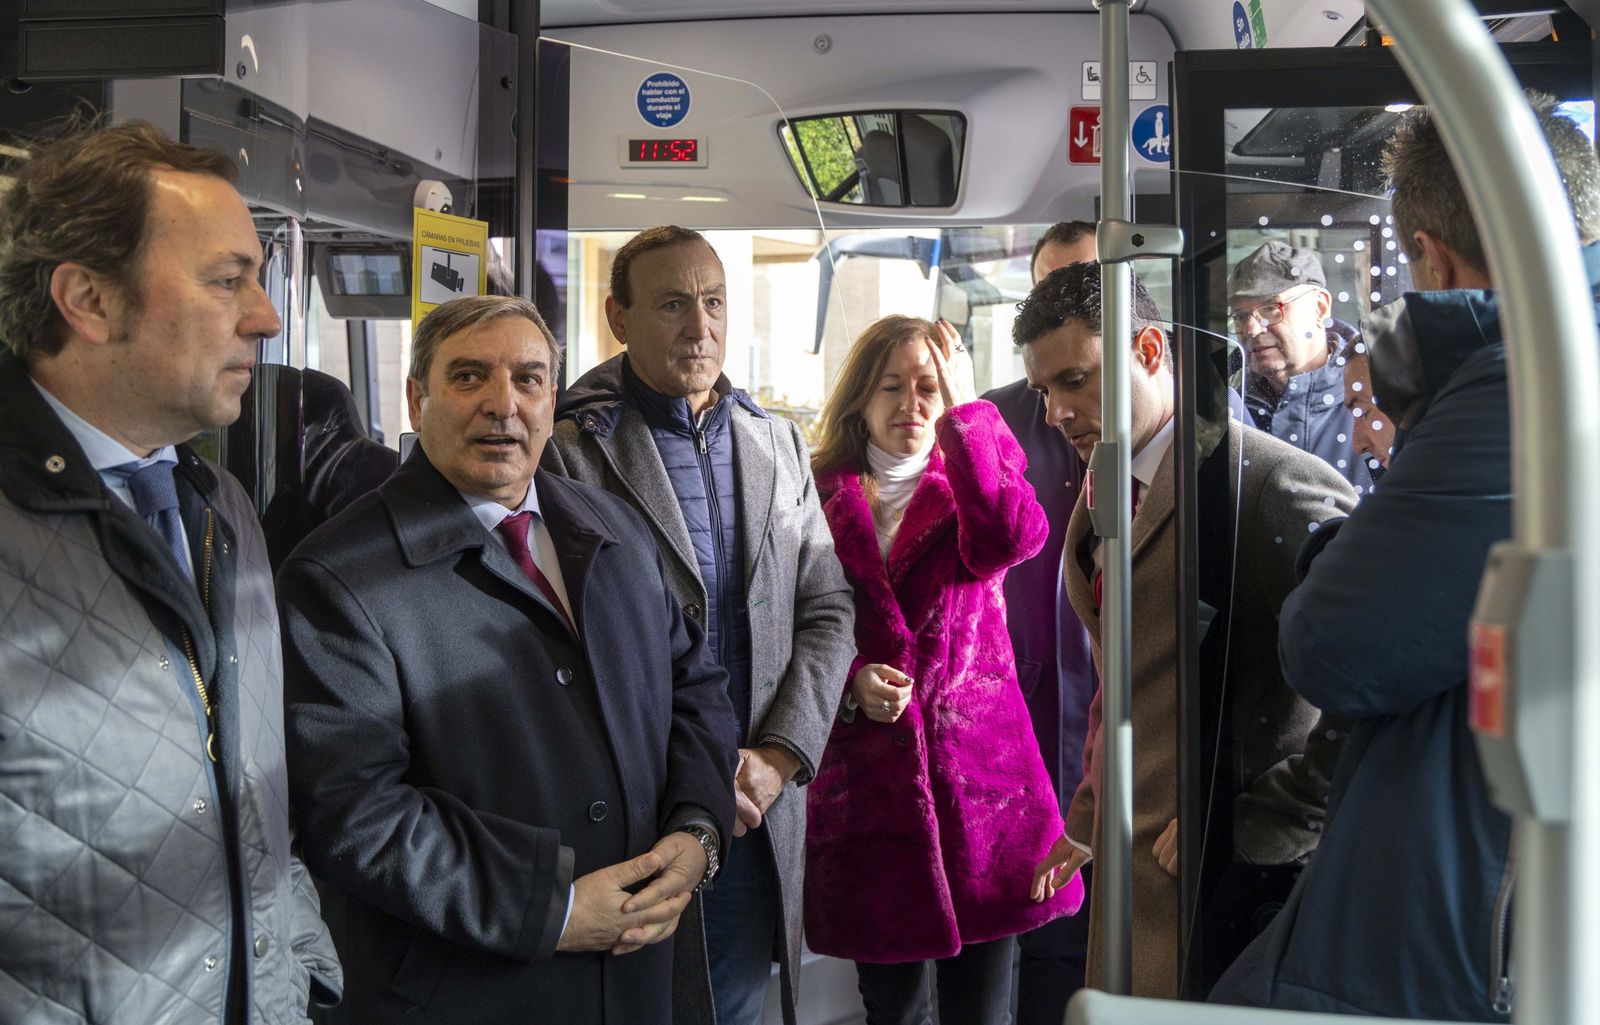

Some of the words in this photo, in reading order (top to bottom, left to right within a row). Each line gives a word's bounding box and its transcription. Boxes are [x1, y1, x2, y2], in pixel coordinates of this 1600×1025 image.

[640, 140, 696, 161] 11:52
[421, 230, 447, 241] CÁMARAS
[447, 235, 456, 243] EN
[456, 237, 480, 248] PRUEBAS
